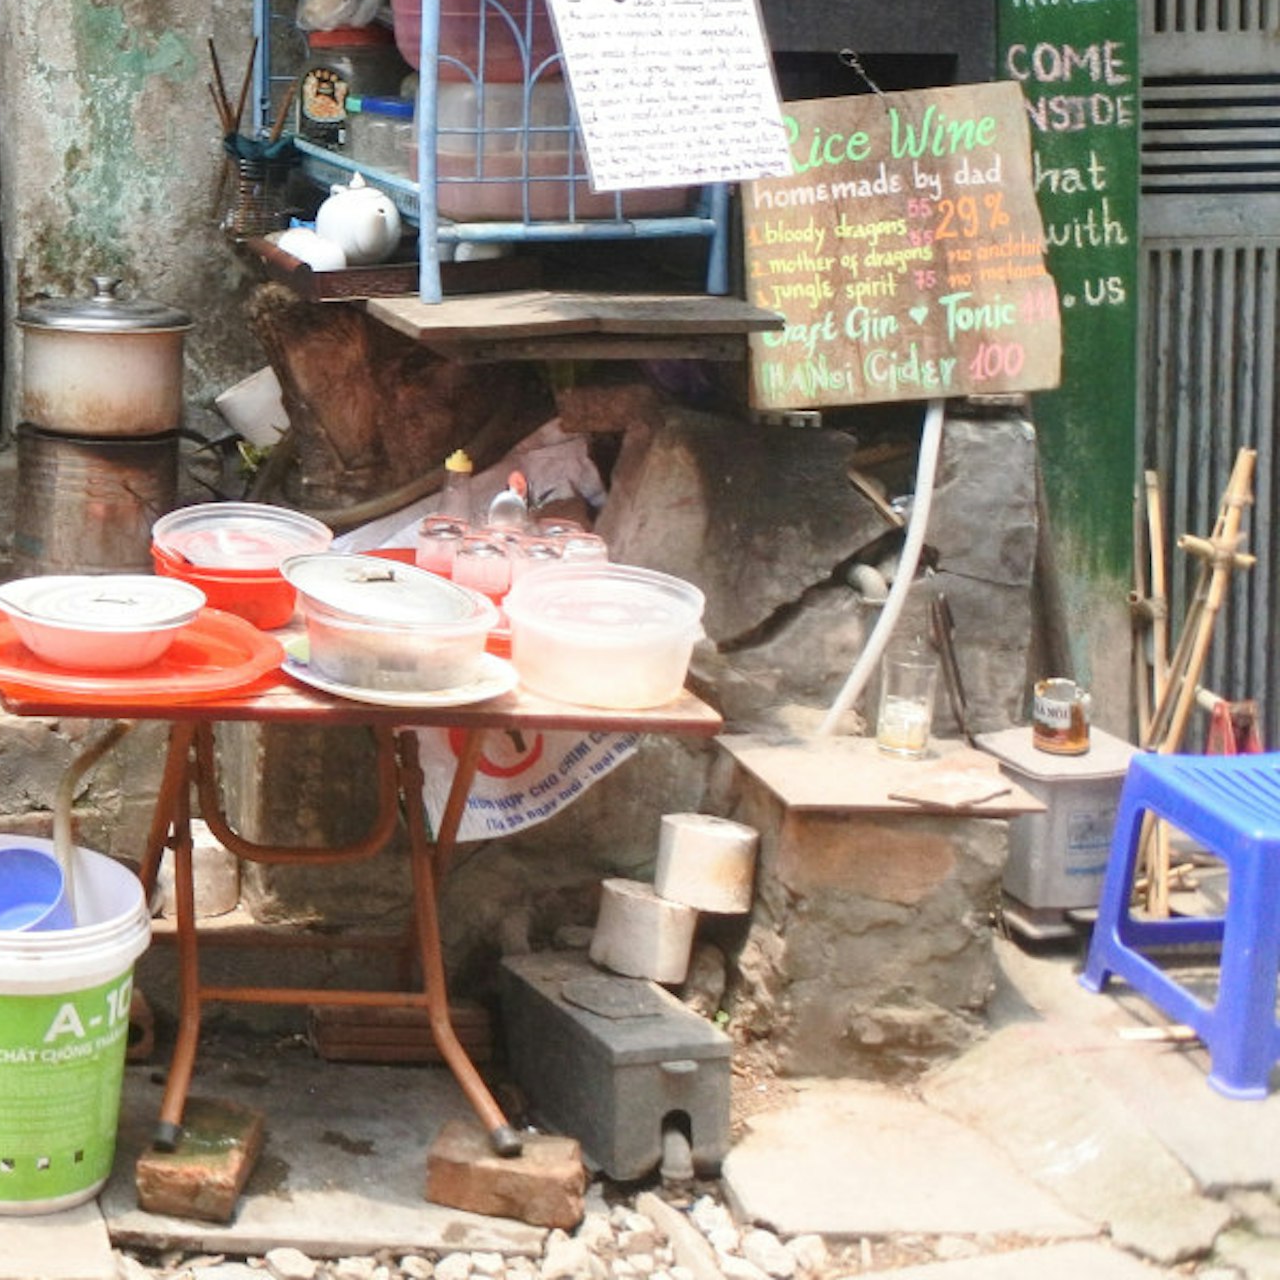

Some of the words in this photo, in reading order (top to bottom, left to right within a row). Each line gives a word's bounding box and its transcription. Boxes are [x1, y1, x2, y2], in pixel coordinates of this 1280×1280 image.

[1006, 40, 1132, 86] COME
[889, 104, 997, 161] Wine
[1023, 92, 1136, 133] NSIDE
[911, 161, 942, 200] by
[954, 158, 1002, 186] dad
[1032, 149, 1108, 195] hat
[764, 216, 826, 253] bloody
[834, 213, 907, 247] dragons
[769, 249, 836, 275] mother
[840, 252, 858, 278] of
[863, 244, 933, 274] dragons
[771, 272, 835, 310] jungle
[846, 271, 899, 306] spirit
[845, 305, 900, 345] Gin
[938, 291, 1017, 344] Tonic
[969, 342, 1025, 382] 100
